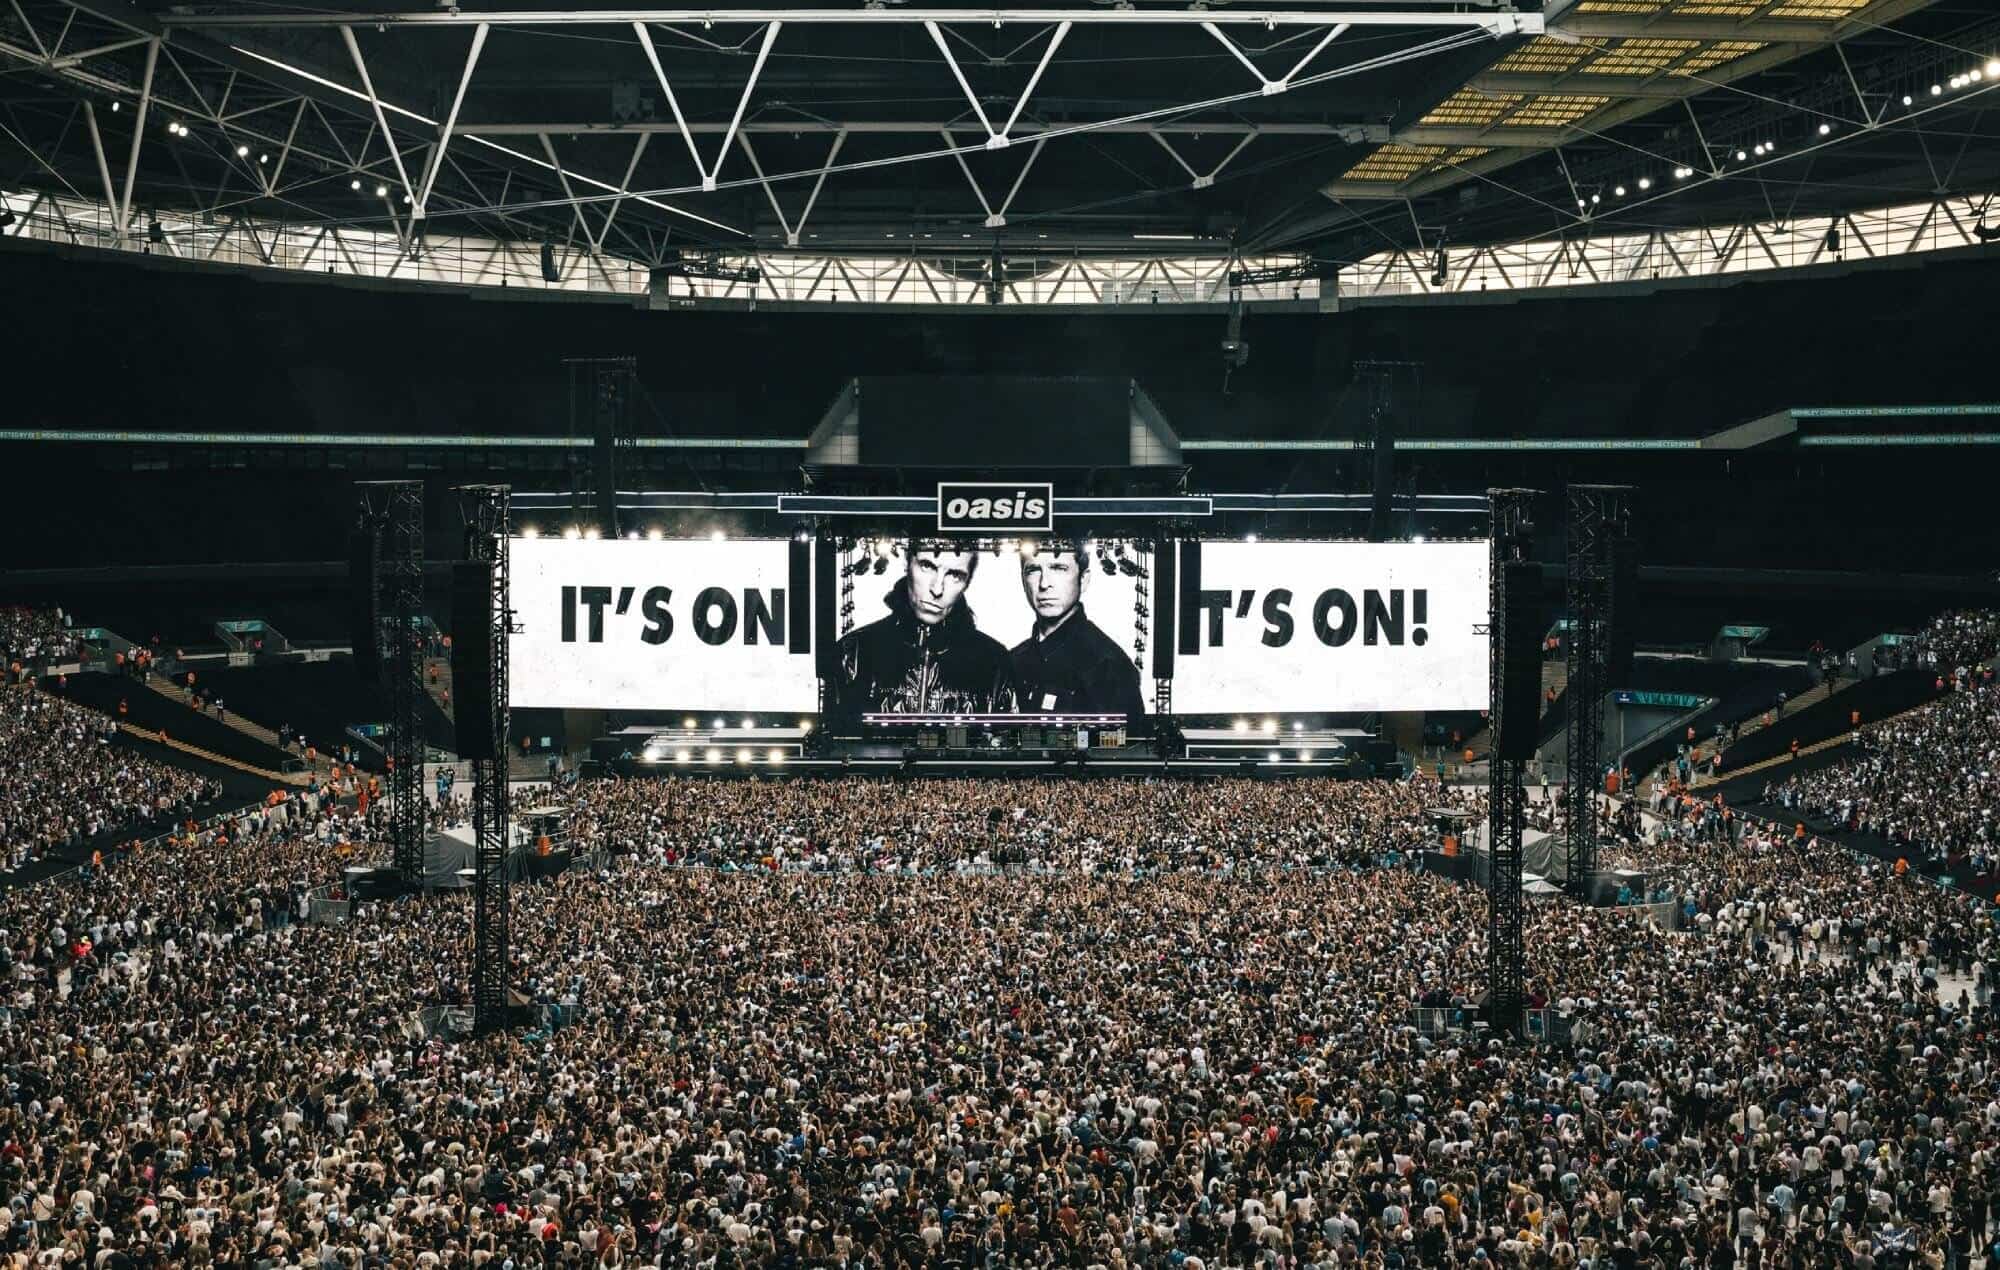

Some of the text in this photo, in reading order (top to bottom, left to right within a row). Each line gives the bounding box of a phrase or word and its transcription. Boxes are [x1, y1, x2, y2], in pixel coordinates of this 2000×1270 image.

[947, 491, 1046, 519] oasis
[561, 586, 674, 645] IT'S
[1199, 587, 1428, 648] T'S ON!
